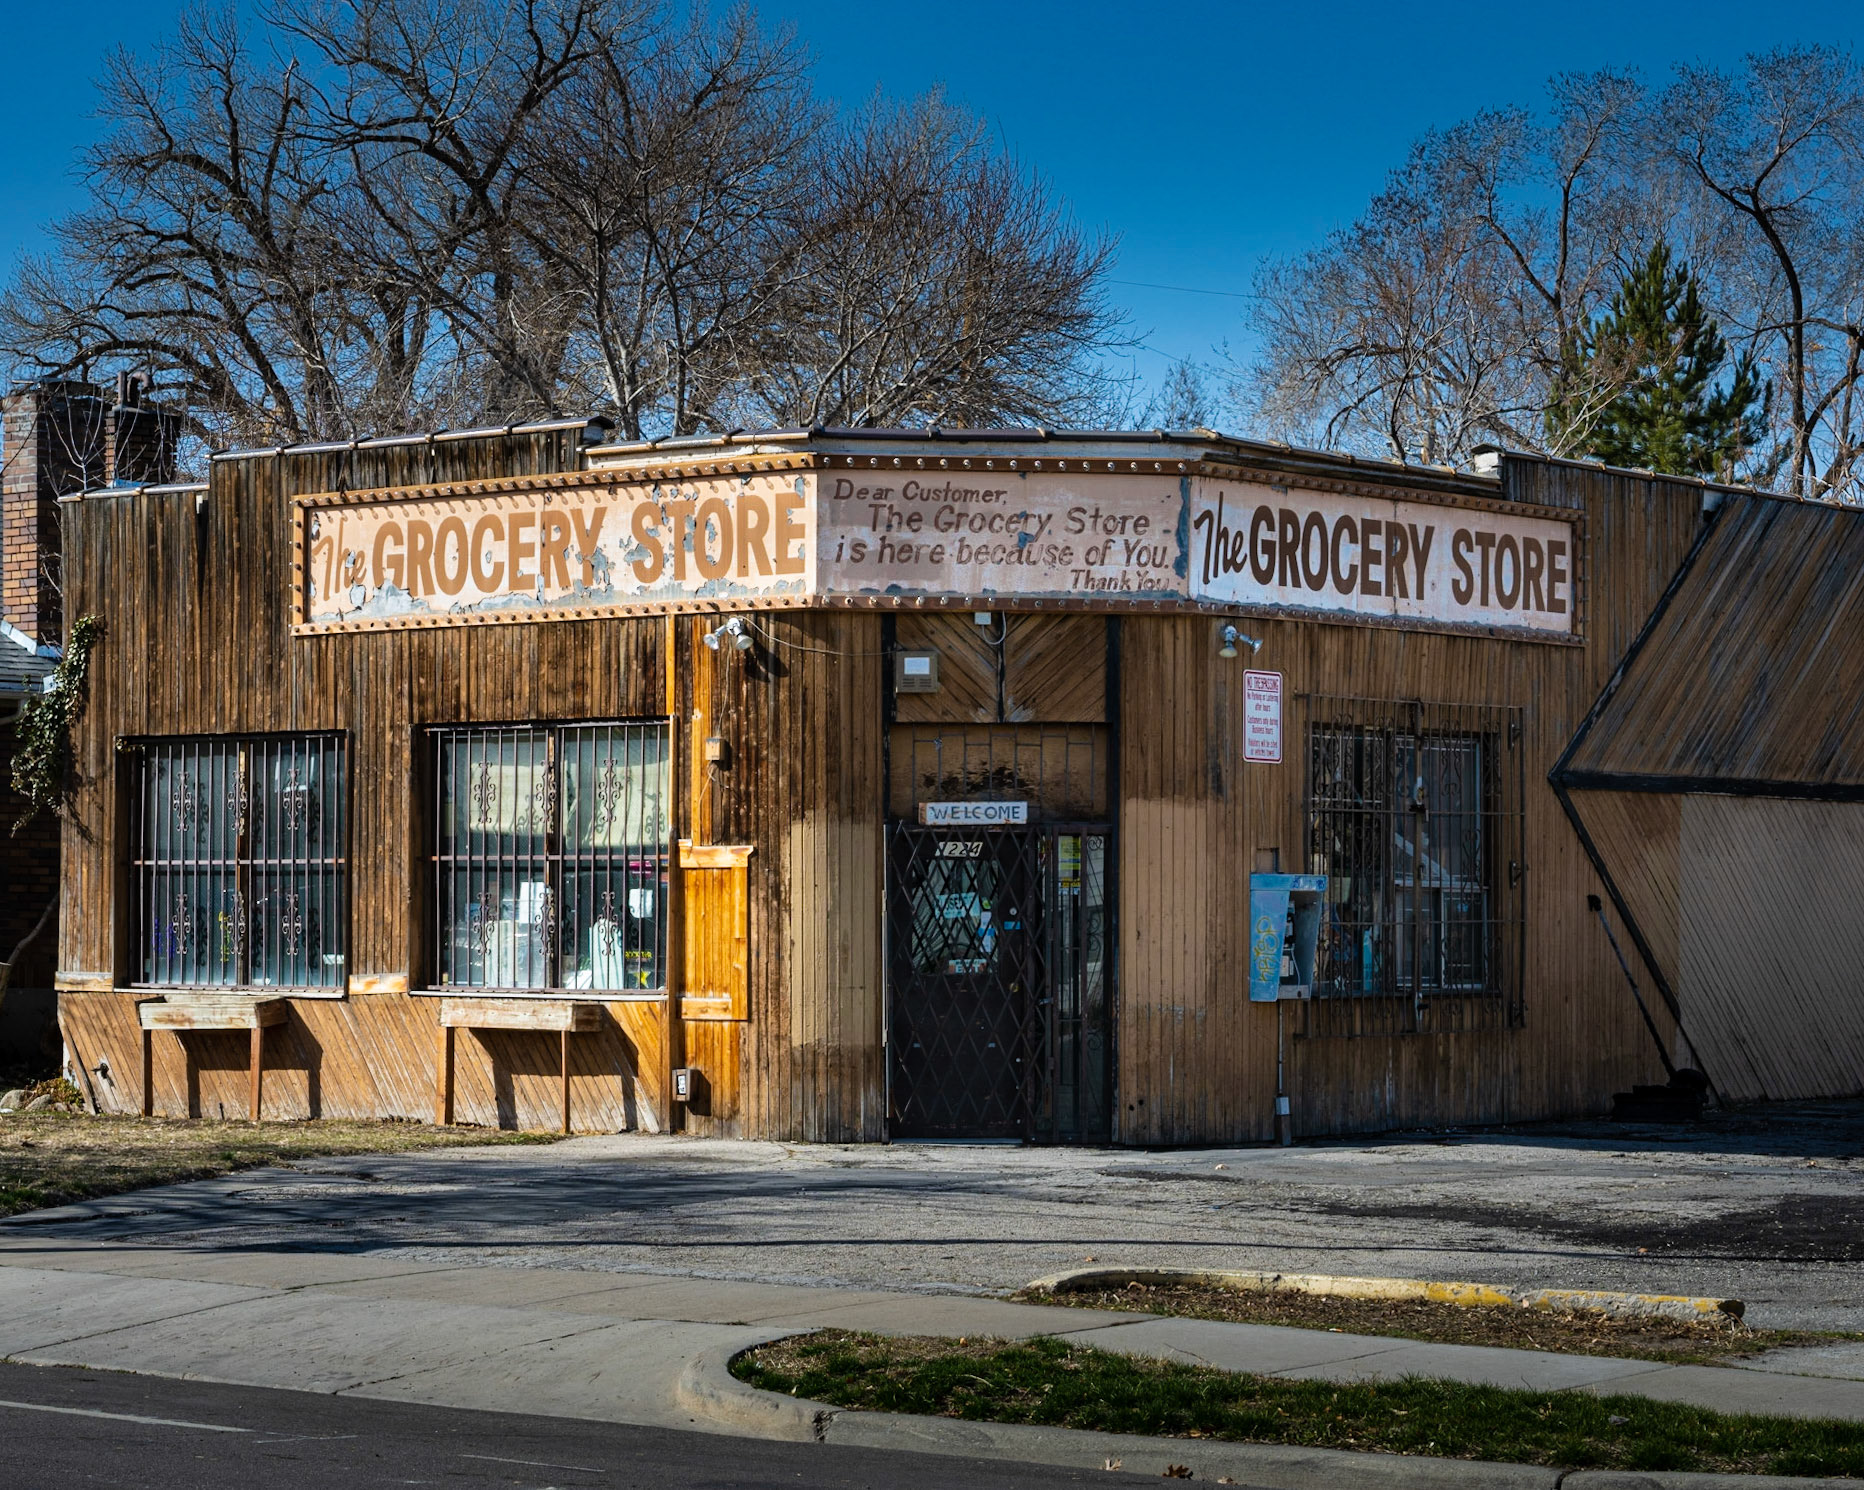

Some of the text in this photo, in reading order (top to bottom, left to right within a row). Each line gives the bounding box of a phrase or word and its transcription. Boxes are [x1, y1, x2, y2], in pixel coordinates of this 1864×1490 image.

[834, 479, 1007, 505] Dear Customer,
[868, 503, 1150, 542] The Grocery Store
[312, 492, 805, 601] The GROCERY STORE
[835, 535, 867, 563] is
[877, 535, 945, 564] here
[956, 536, 1074, 566] because
[1084, 538, 1116, 566] of
[1194, 491, 1566, 614] The GROCERY STORE
[1070, 569, 1170, 590] Thank You
[929, 805, 1020, 820] WELCOME
[938, 842, 981, 856] 224
